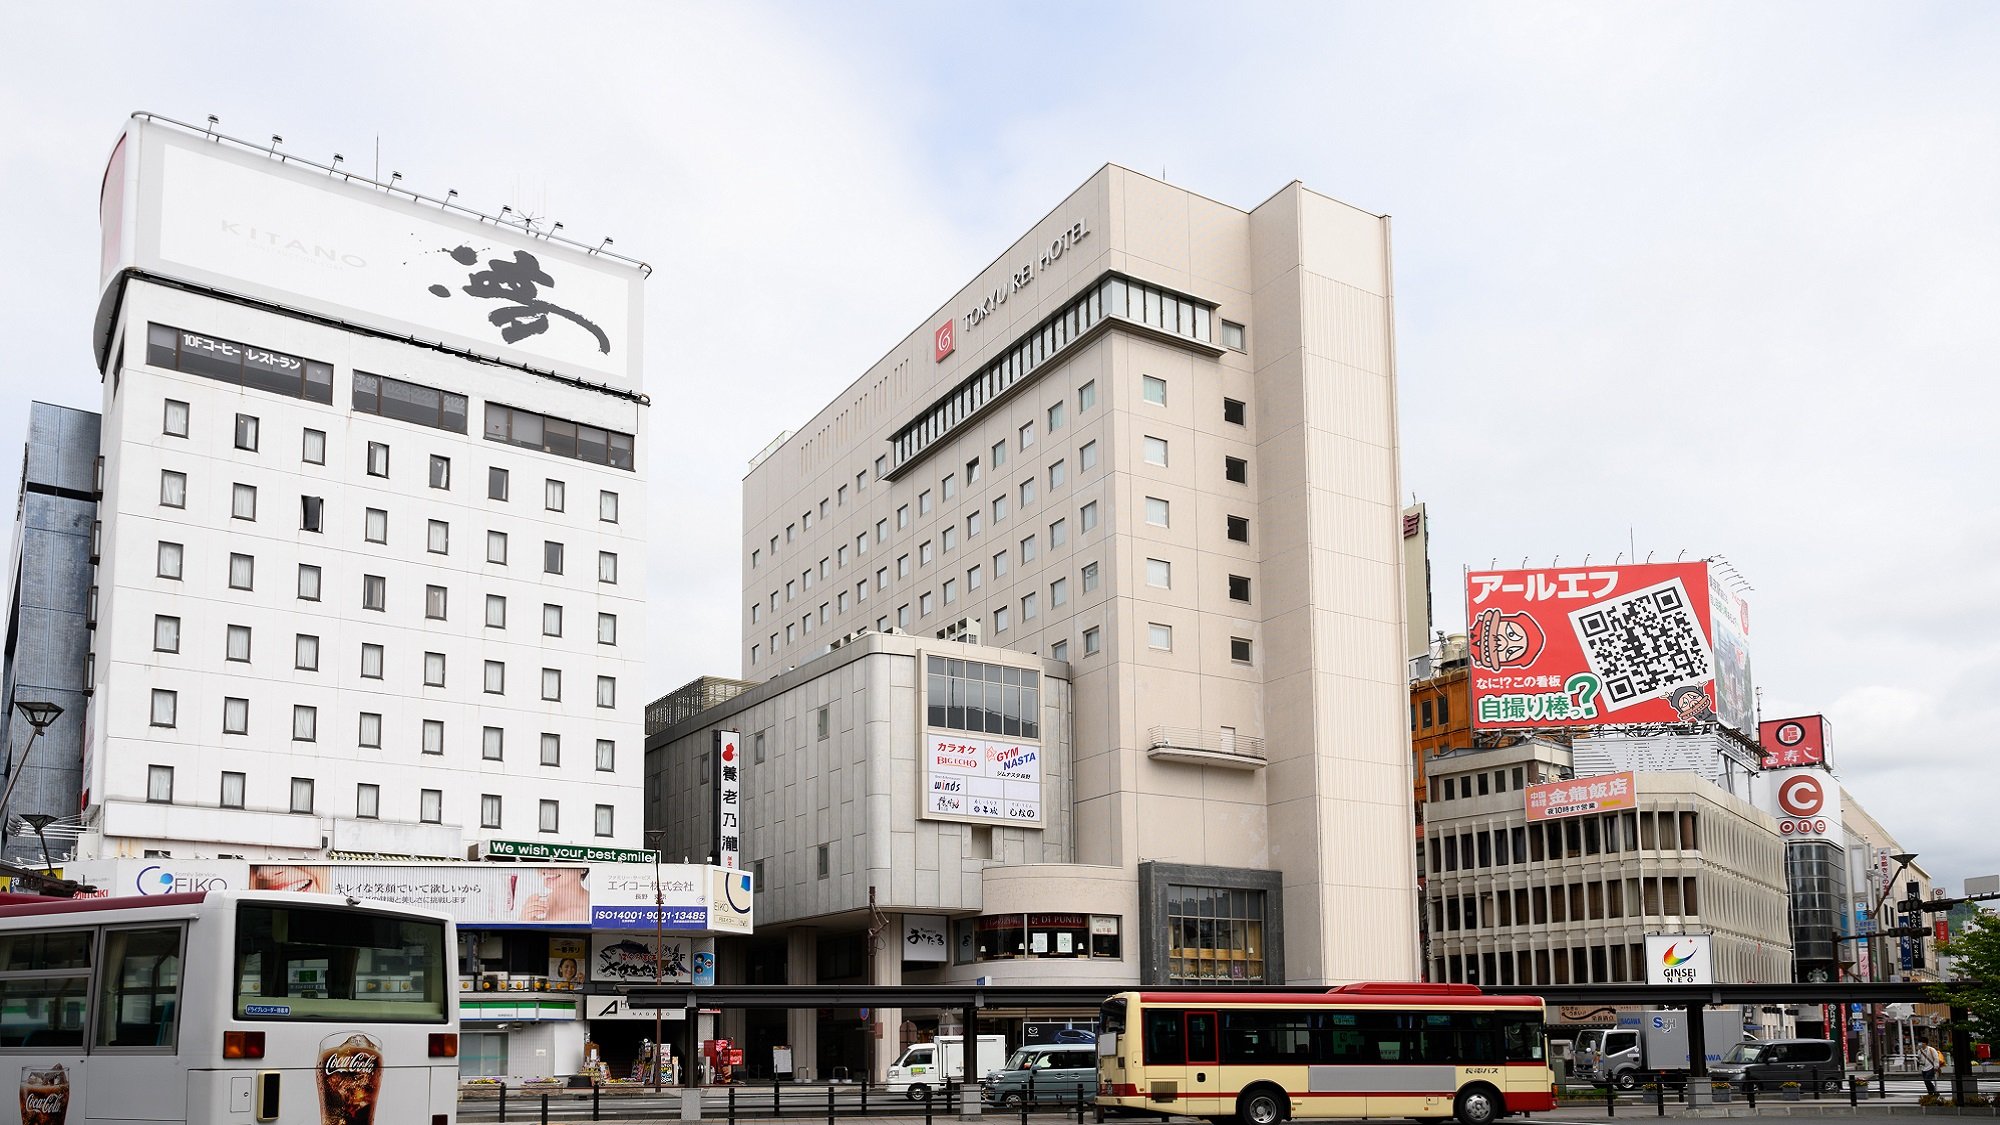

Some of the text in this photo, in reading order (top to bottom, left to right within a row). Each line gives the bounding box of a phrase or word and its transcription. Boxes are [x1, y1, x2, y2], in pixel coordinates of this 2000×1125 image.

[221, 219, 367, 268] KITANO
[963, 217, 1091, 332] TOKYU REI HOTEL
[1471, 571, 1619, 604] アールエフ
[937, 743, 977, 754] カラオケ
[996, 746, 1019, 762] GYM
[937, 756, 977, 768] BIG ECHO
[1003, 752, 1036, 771] NASTA
[934, 780, 961, 792] winds
[1548, 778, 1628, 806] 金龍飯店
[722, 765, 738, 852] 養老乃瀧
[1547, 802, 1596, 815] 夜10時まで営業
[1780, 819, 1827, 834] one
[492, 842, 514, 853] We
[518, 844, 549, 856] wish
[552, 848, 583, 858] your
[587, 849, 616, 860] best
[335, 883, 482, 894] キレイな笑顔でいて欲しいから
[608, 880, 695, 892] エイコー株式会社
[714, 901, 730, 913] EIKO
[1041, 915, 1054, 924] DI
[672, 953, 685, 962] 2F
[1663, 968, 1696, 977] GINSEI
